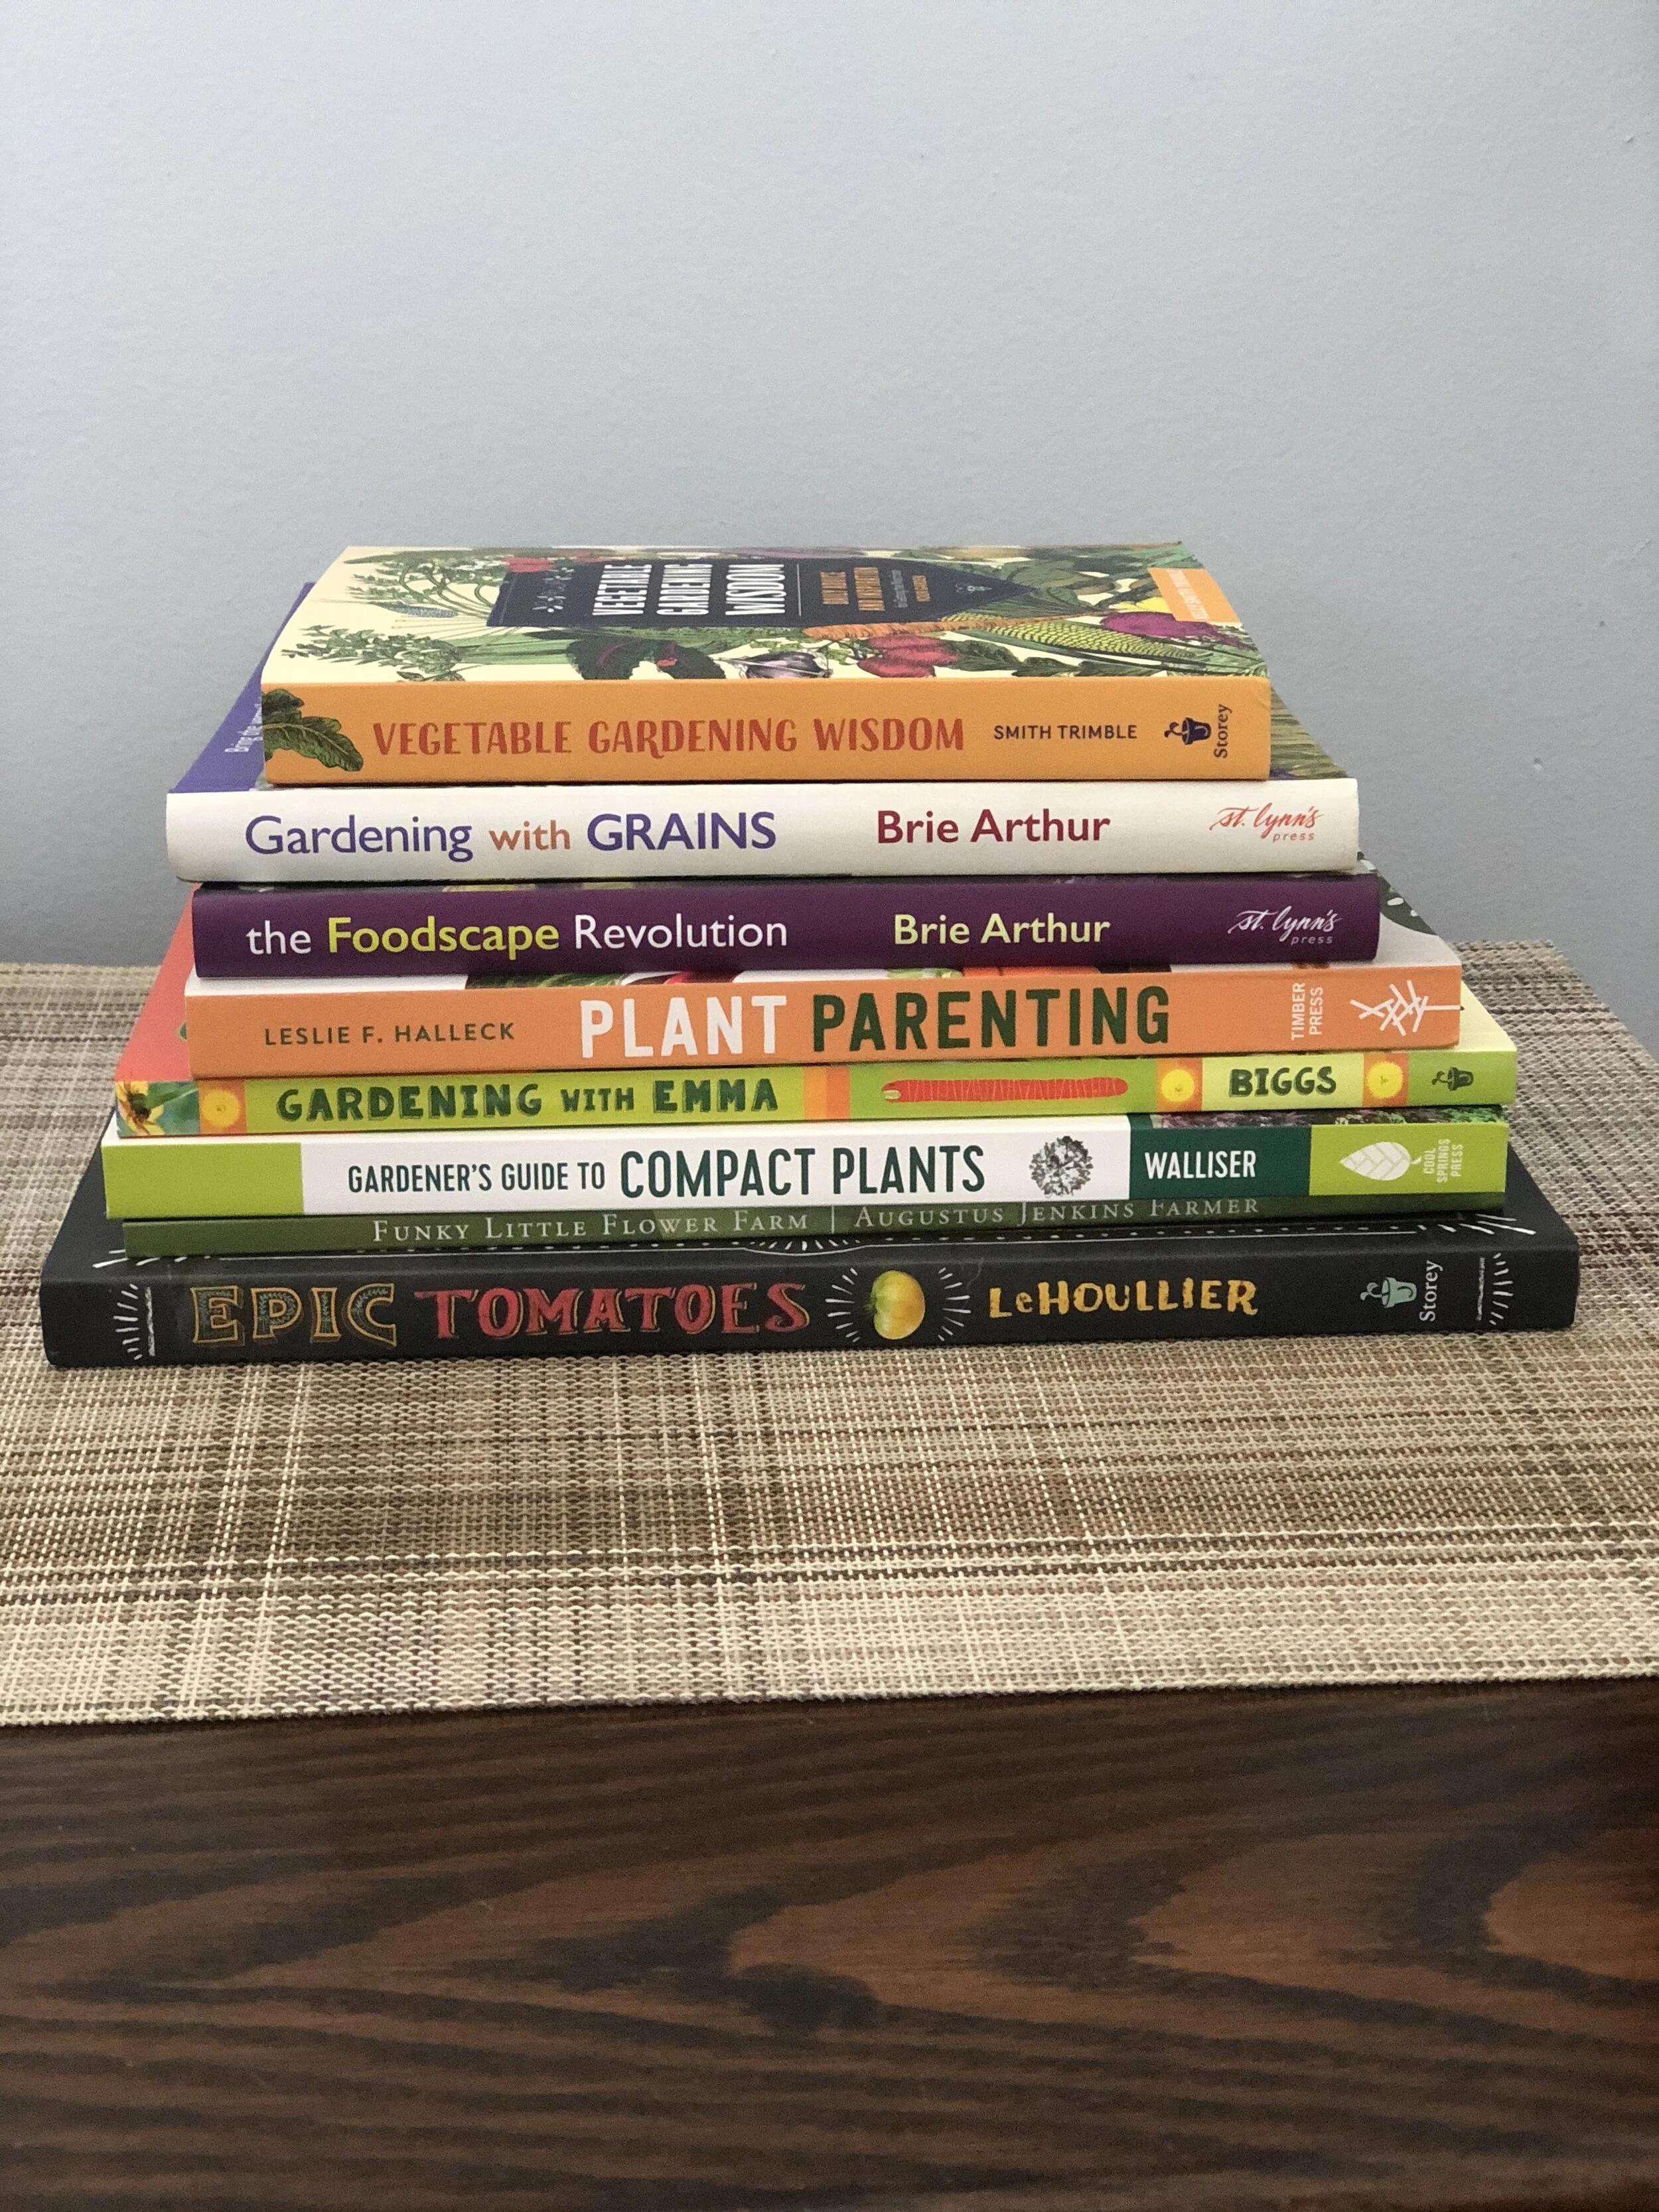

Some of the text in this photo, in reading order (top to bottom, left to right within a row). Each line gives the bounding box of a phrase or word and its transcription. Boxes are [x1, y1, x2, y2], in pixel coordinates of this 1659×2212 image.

[592, 564, 652, 616] VEGETABLE
[657, 564, 713, 615] GARDENING
[725, 564, 786, 615] WISDOM
[373, 717, 964, 759] VEGETABLE GARDENING WISDOM
[993, 724, 1137, 740] SMITH TRIMBLE
[1214, 703, 1233, 759] Storey
[246, 812, 776, 862] Gardening with GRAINS
[877, 808, 1111, 843] Brie Arthur
[1253, 802, 1323, 839] lynn's
[1273, 831, 1315, 843] press
[246, 913, 787, 960] the Foodscape Revolution
[894, 913, 1111, 945] Brie Arthur
[1272, 905, 1342, 942] lynn's
[1291, 934, 1333, 946] press
[581, 986, 1169, 1058] PLANT PARENTING
[1291, 982, 1306, 1041] TIMBER
[1309, 986, 1324, 1035] PRESS
[265, 1022, 515, 1046] LESLIE F. HALLECK
[276, 1078, 778, 1122] GARDENING WITH EMMA
[1229, 1066, 1336, 1098] BIGGS
[348, 1145, 985, 1198] GARDENER'S GUIDE TO COMPACT PLANTS
[1145, 1150, 1256, 1179] WALLISER
[1423, 1147, 1436, 1175] COOL
[1436, 1138, 1451, 1183] SPRINGS
[1451, 1143, 1464, 1177] PRESS
[989, 1276, 1258, 1319] LeHOULLIER
[1419, 1260, 1443, 1323] Storey
[190, 1282, 810, 1349] EPIC TOMATOES
